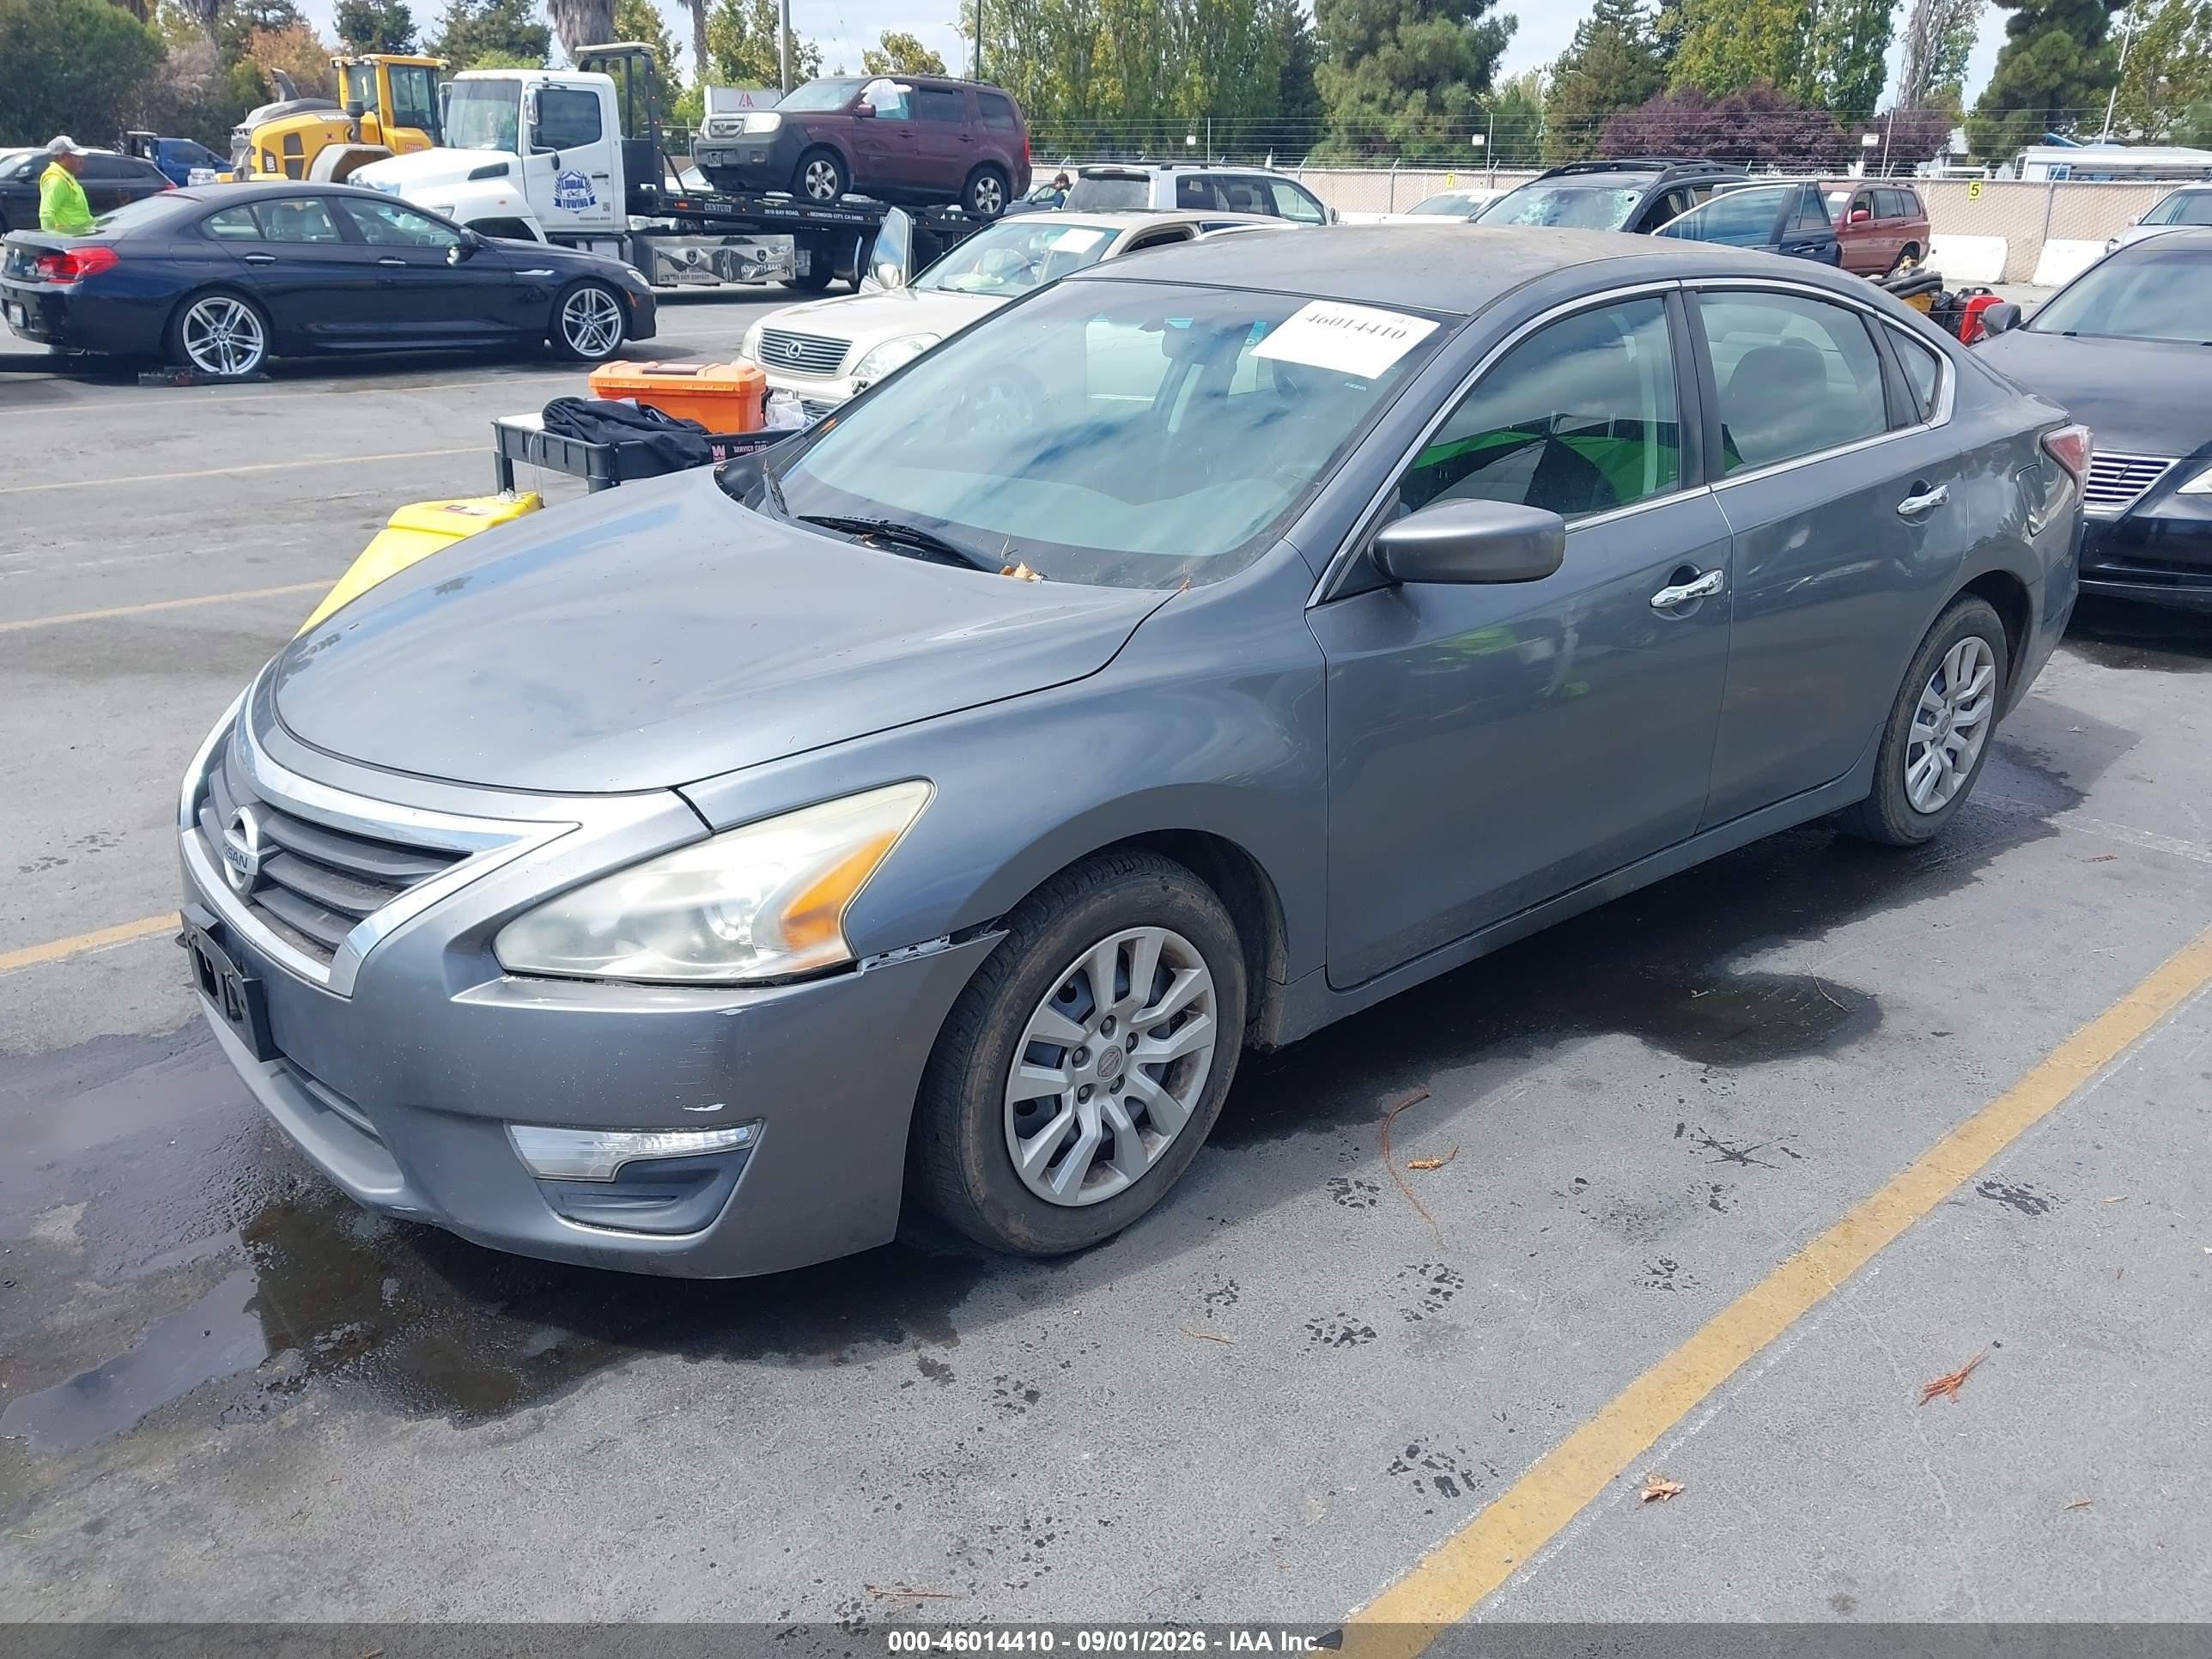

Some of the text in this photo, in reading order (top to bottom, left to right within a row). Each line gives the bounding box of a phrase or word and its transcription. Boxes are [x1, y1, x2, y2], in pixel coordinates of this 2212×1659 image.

[1448, 174, 1454, 185] 7
[1971, 183, 1980, 197] 5
[562, 198, 589, 210] TOWING
[704, 203, 732, 213] CENTURY
[1304, 313, 1408, 341] 46014410
[223, 843, 248, 869] SSAN
